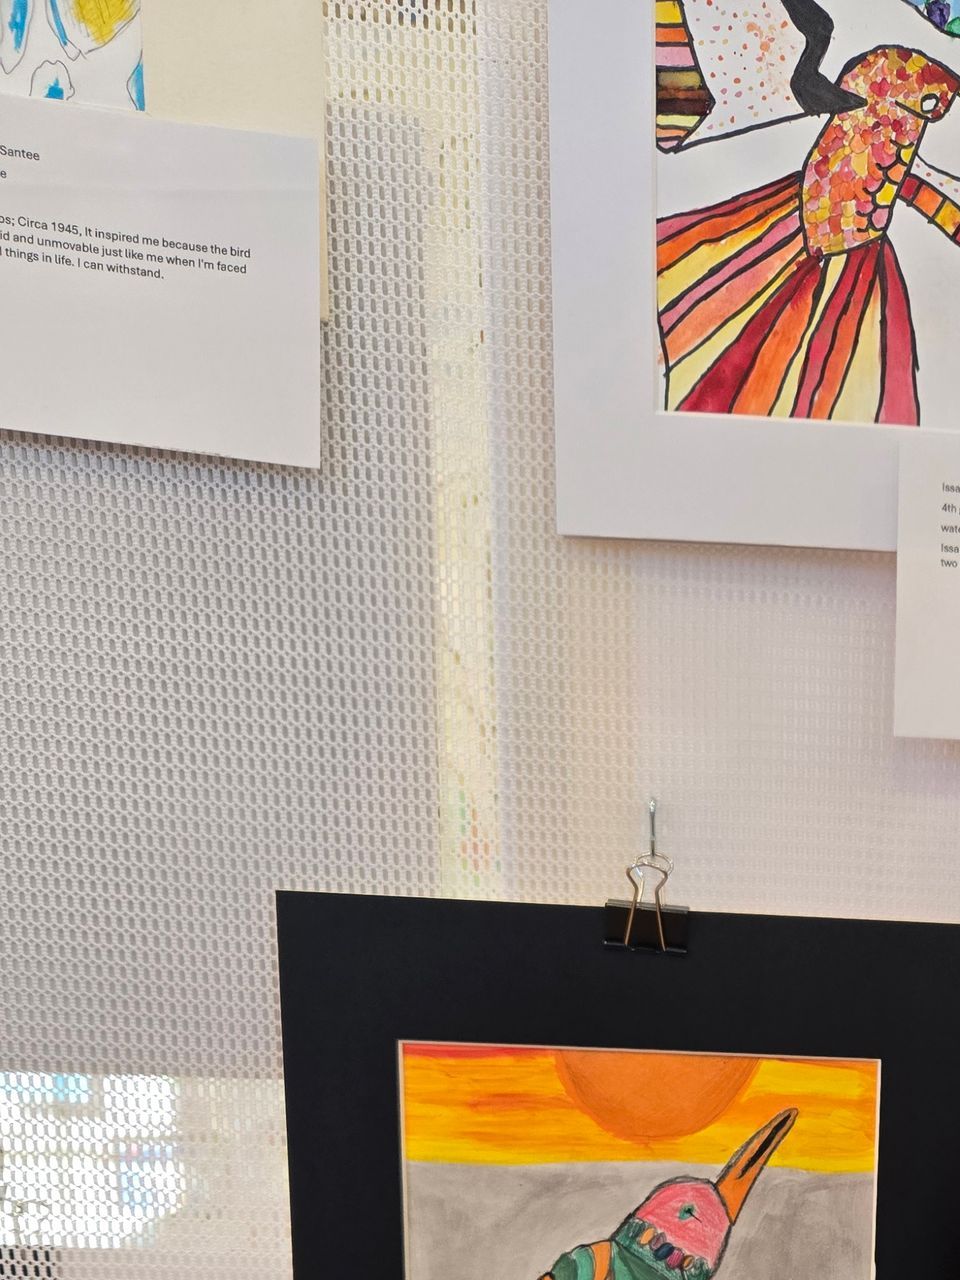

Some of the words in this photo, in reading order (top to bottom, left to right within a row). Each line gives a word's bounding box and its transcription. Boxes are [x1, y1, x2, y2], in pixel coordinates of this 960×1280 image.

[0, 145, 40, 161] Santee
[17, 216, 48, 231] Circa
[85, 227, 92, 237] It
[95, 229, 139, 244] inspired
[142, 237, 159, 246] me
[162, 237, 208, 253] because
[210, 244, 228, 256] the
[230, 246, 251, 259] bird
[5, 248, 39, 263] things
[42, 252, 52, 264] in
[55, 254, 75, 267] life.
[83, 261, 104, 271] can
[13, 234, 34, 245] and
[37, 237, 99, 255] unmovable
[101, 245, 122, 259] just
[125, 248, 144, 261] like
[146, 253, 164, 263] me
[166, 256, 195, 268] when
[198, 258, 214, 271] I'm
[217, 261, 247, 274] faced
[942, 482, 960, 494] Issa
[941, 503, 957, 513] 4th
[941, 544, 960, 554] Issa
[940, 559, 958, 568] two
